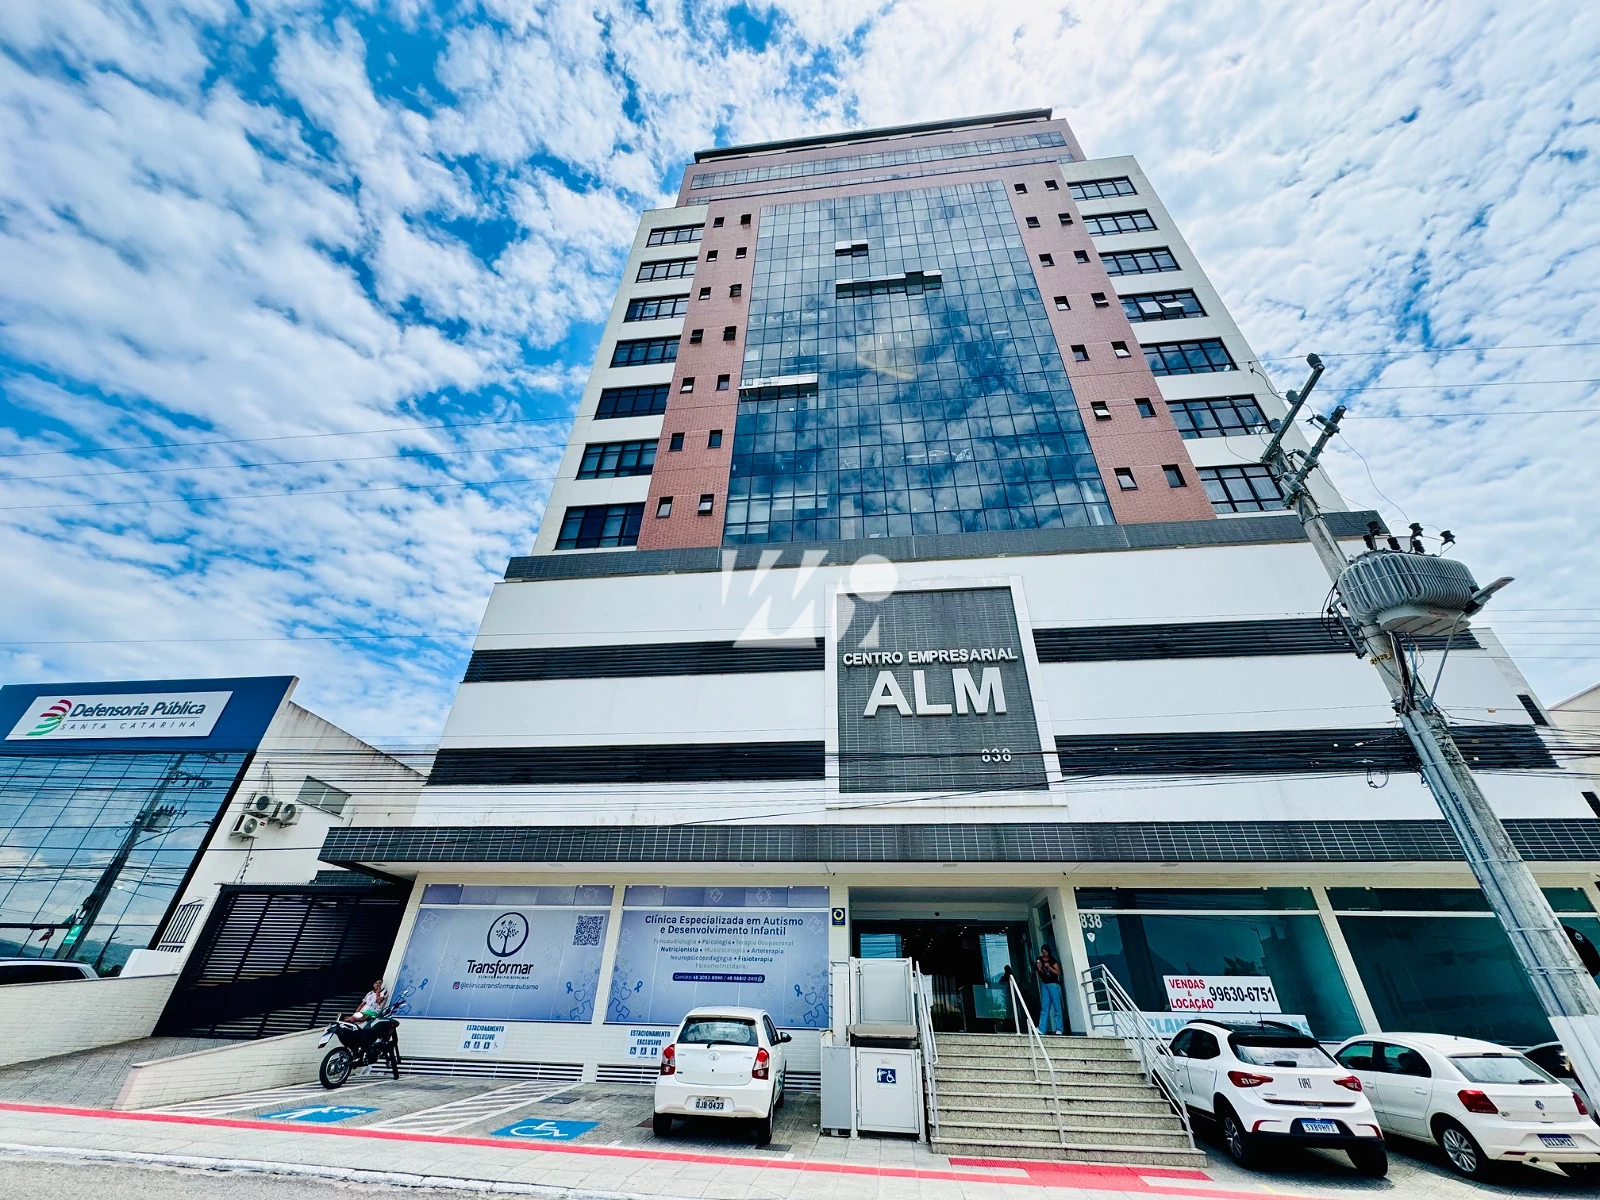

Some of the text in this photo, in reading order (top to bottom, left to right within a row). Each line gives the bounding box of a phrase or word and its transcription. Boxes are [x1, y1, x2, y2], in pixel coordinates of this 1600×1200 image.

[843, 648, 1018, 666] CENTRO EMPRESARIAL
[863, 667, 1007, 717] ALM
[69, 701, 206, 717] Defensoria Pública
[60, 721, 196, 731] SANTA CATARINA
[645, 914, 677, 924] Clínica
[679, 915, 744, 926] Especializada
[763, 917, 804, 926] Autismo
[1080, 913, 1102, 928] 838
[660, 925, 786, 935] e Desenvolvimento Infantil
[737, 955, 773, 963] Fisioterapia
[467, 960, 534, 979] Transformar
[1168, 979, 1276, 1002] VENDAS 99630-6751
[1170, 997, 1214, 1010] LOCAÇÃO
[466, 1024, 505, 1032] ESTACIONAMENTO
